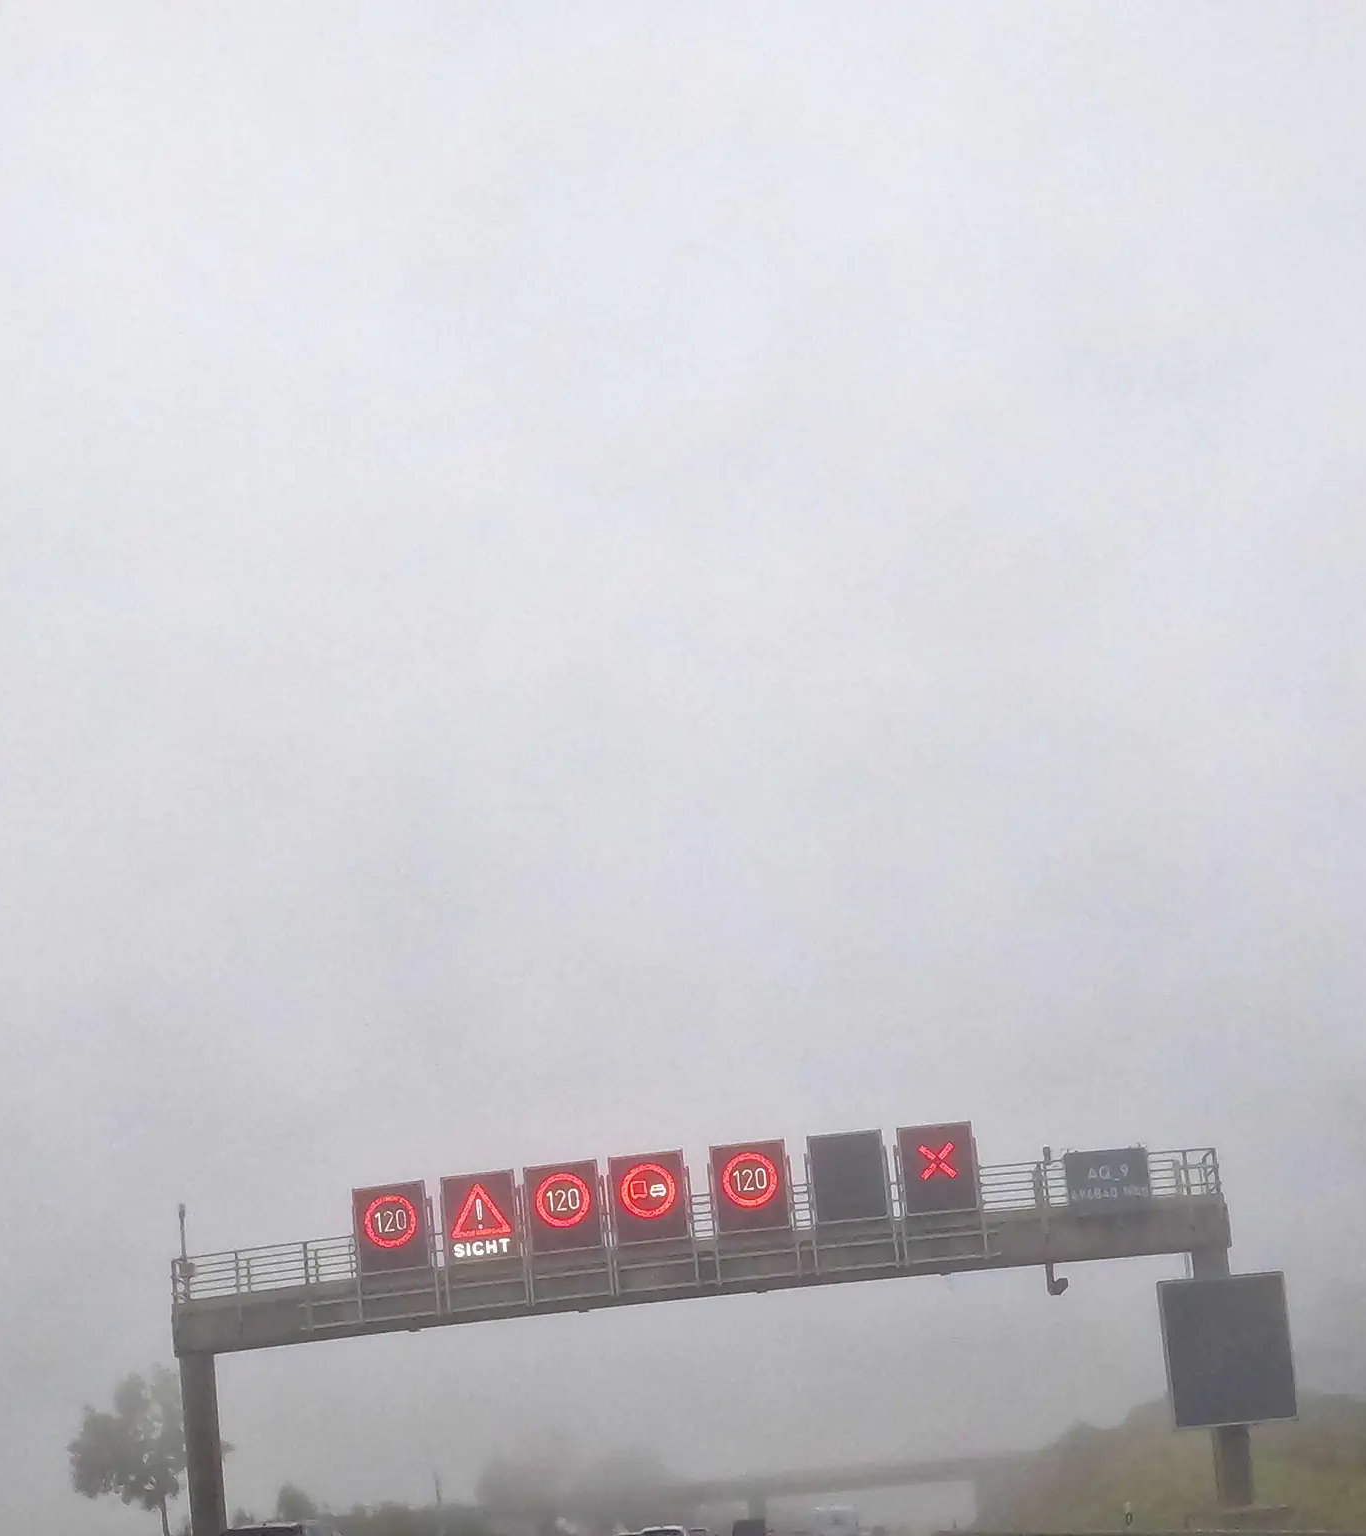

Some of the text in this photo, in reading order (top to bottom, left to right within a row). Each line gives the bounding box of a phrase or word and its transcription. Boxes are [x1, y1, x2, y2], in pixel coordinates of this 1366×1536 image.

[732, 1167, 768, 1192] 120
[545, 1187, 580, 1212] 120
[374, 1208, 407, 1233] 120
[453, 1237, 511, 1259] SICHT
